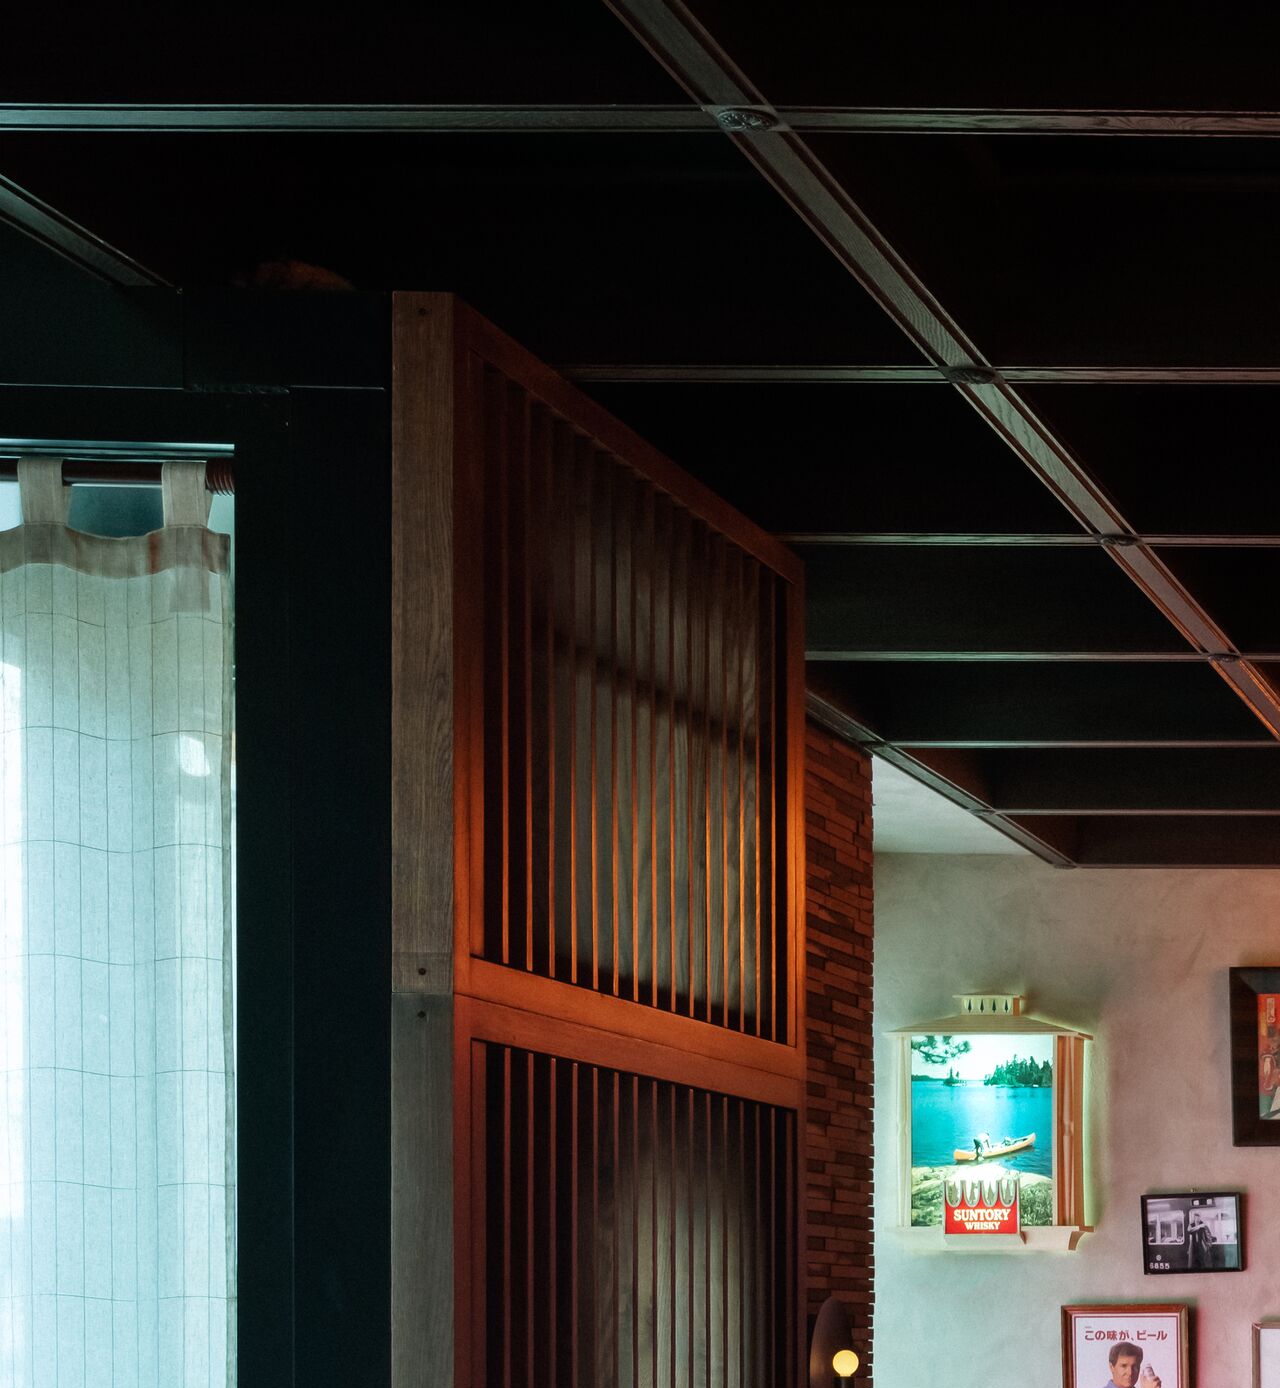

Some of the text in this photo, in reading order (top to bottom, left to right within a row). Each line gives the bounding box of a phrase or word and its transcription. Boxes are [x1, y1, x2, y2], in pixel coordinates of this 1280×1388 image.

[953, 1208, 1011, 1221] SUNTORY
[964, 1221, 1001, 1230] WHISKY
[1084, 1329, 1168, 1341] この味が、ビール
